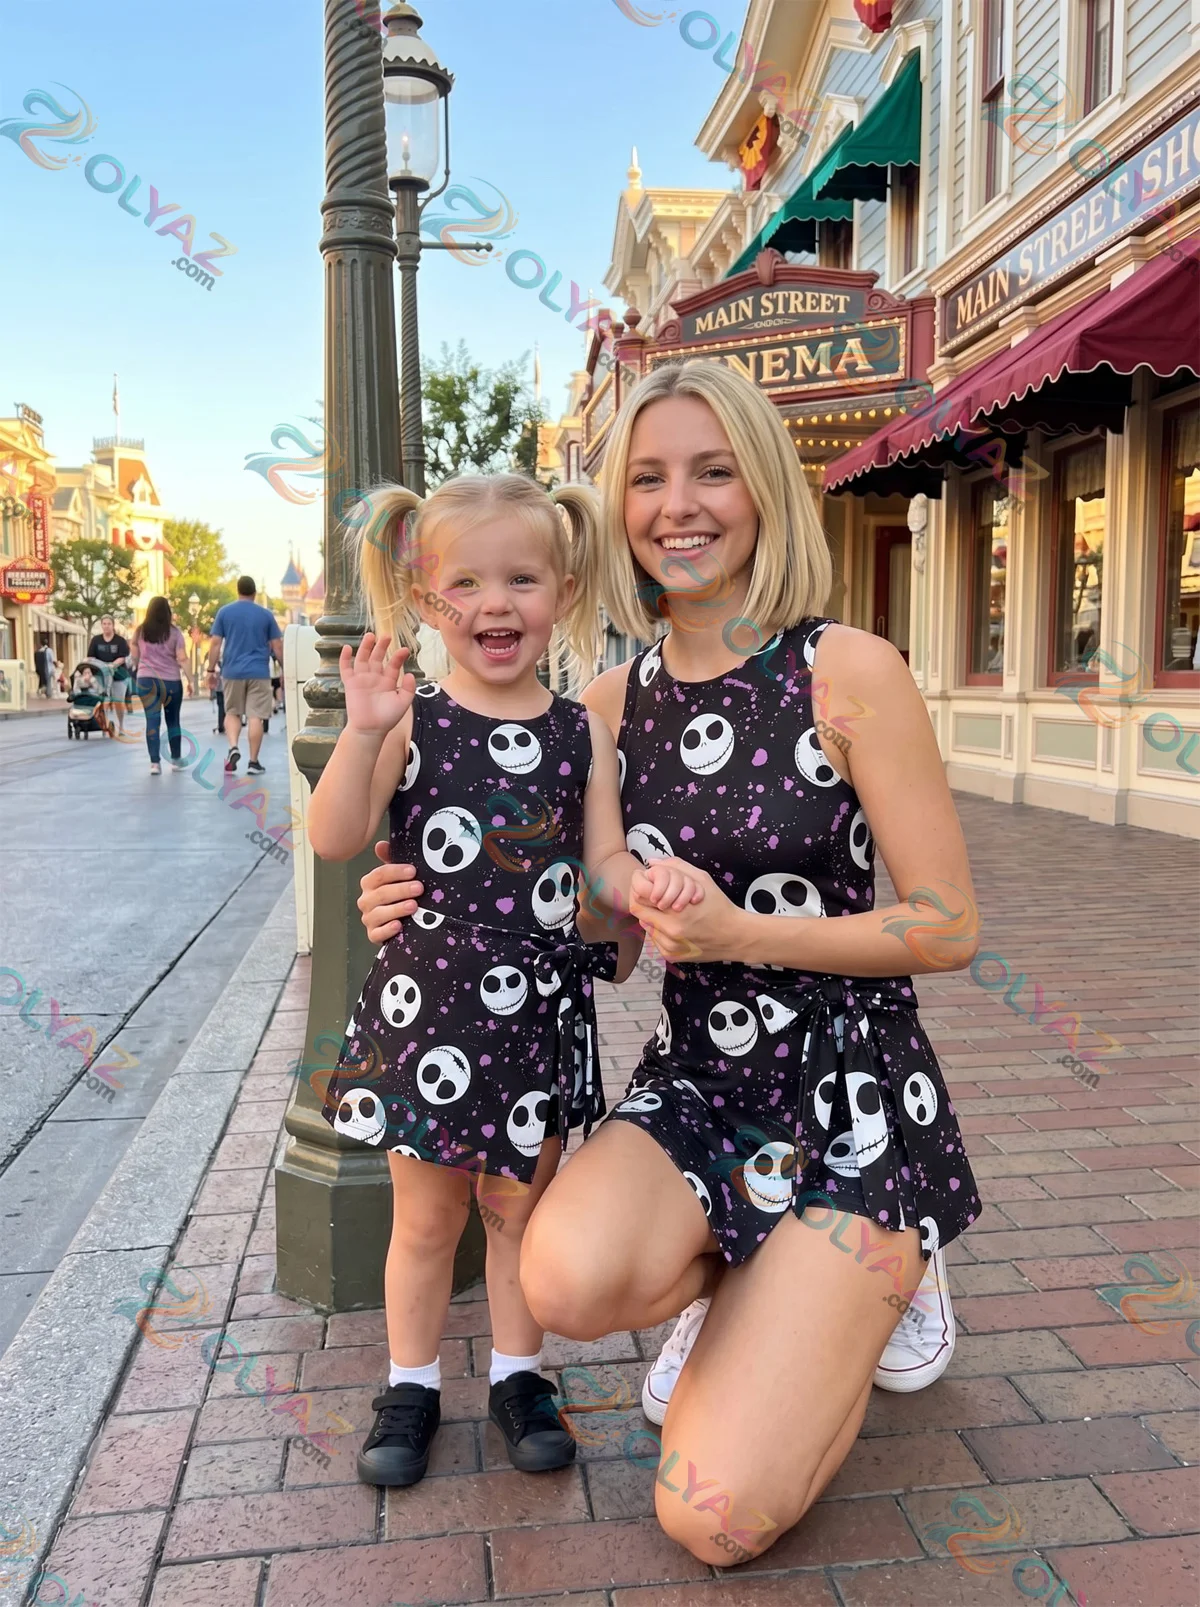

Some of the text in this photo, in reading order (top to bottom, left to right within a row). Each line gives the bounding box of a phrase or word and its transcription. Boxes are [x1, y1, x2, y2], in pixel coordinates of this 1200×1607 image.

[956, 260, 1011, 330] MAIN
[1018, 171, 1129, 287] STREET
[694, 290, 850, 335] MAIN STREET
[684, 336, 875, 385] NEMA
